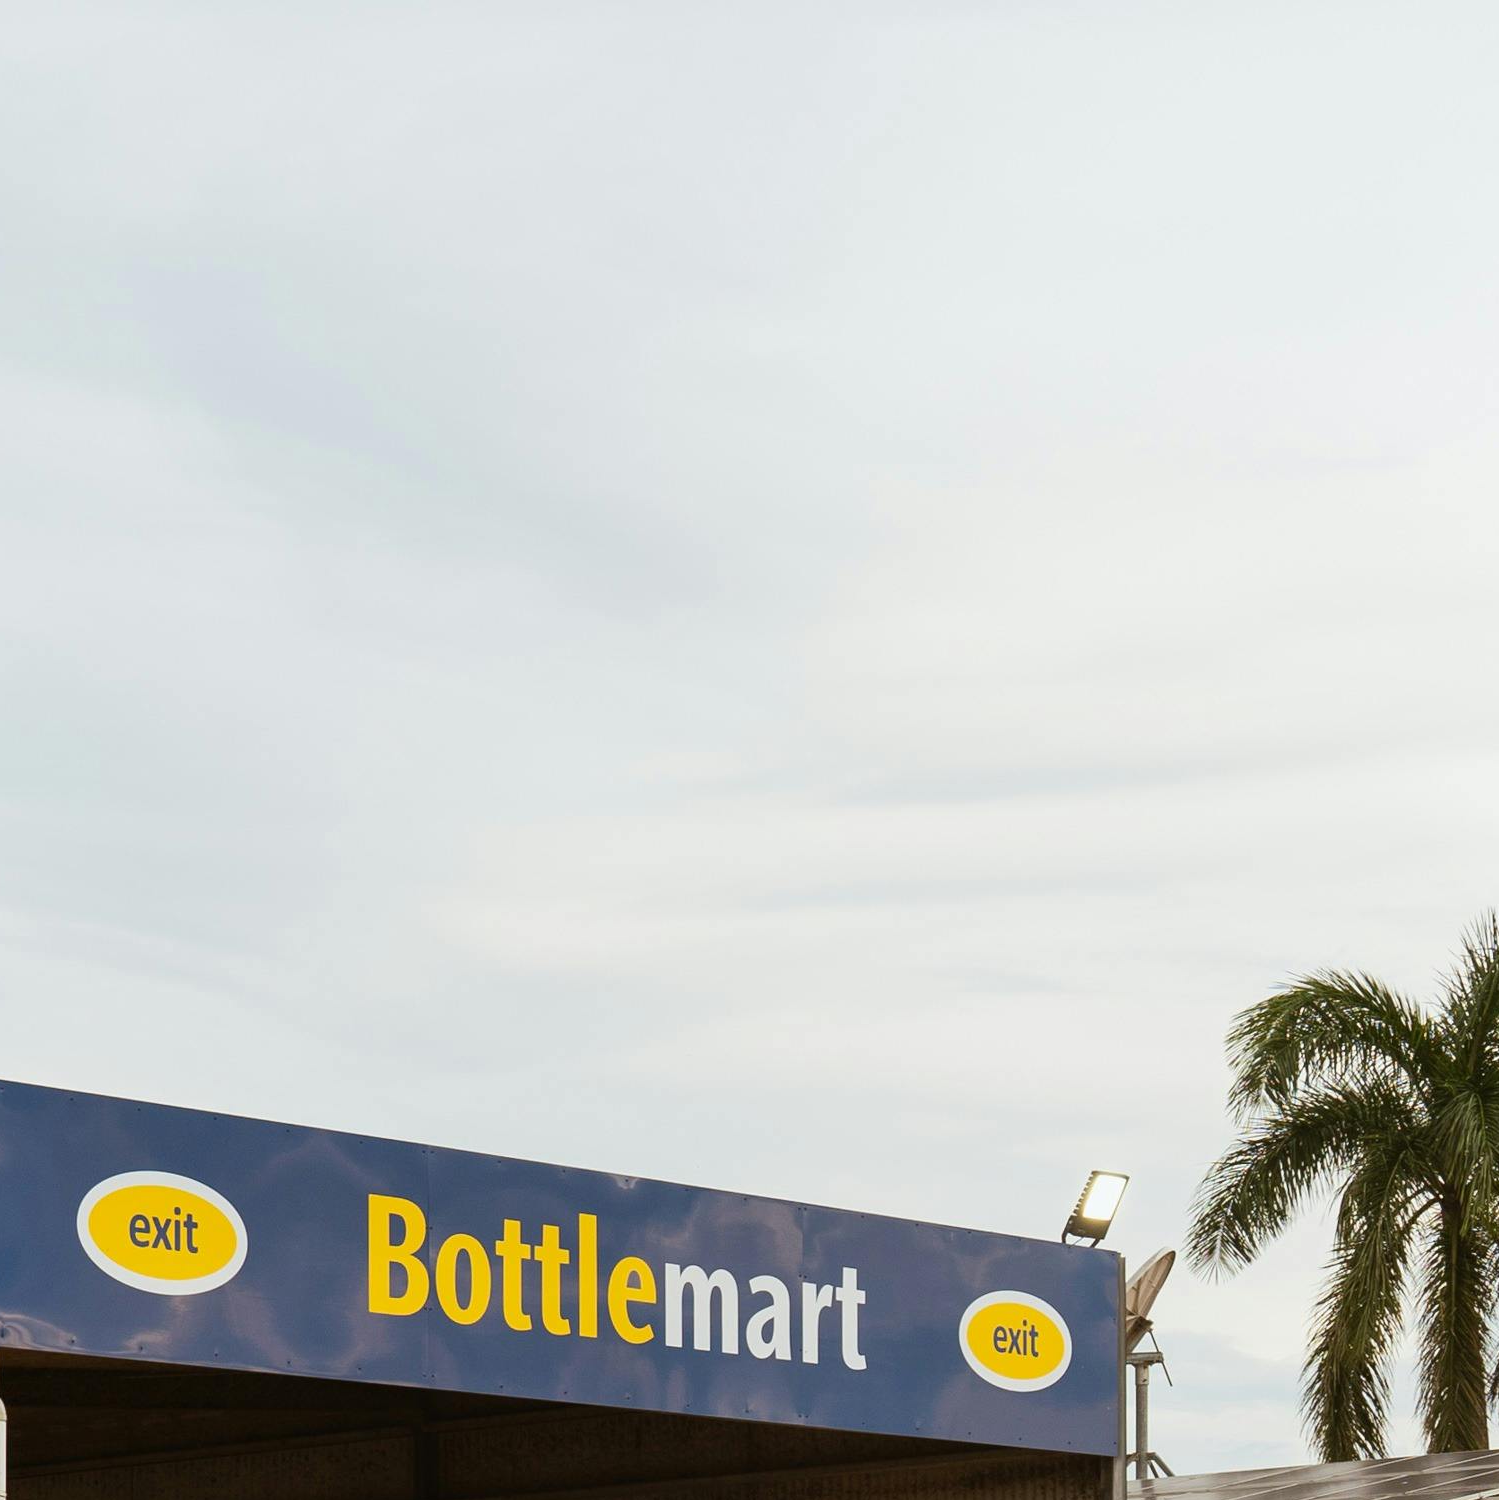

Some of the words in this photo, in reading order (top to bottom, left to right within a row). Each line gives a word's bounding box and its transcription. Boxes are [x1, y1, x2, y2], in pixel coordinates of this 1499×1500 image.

[128, 1206, 199, 1254] exit
[367, 1193, 868, 1371] Bottlemart
[992, 1319, 1039, 1358] exit
